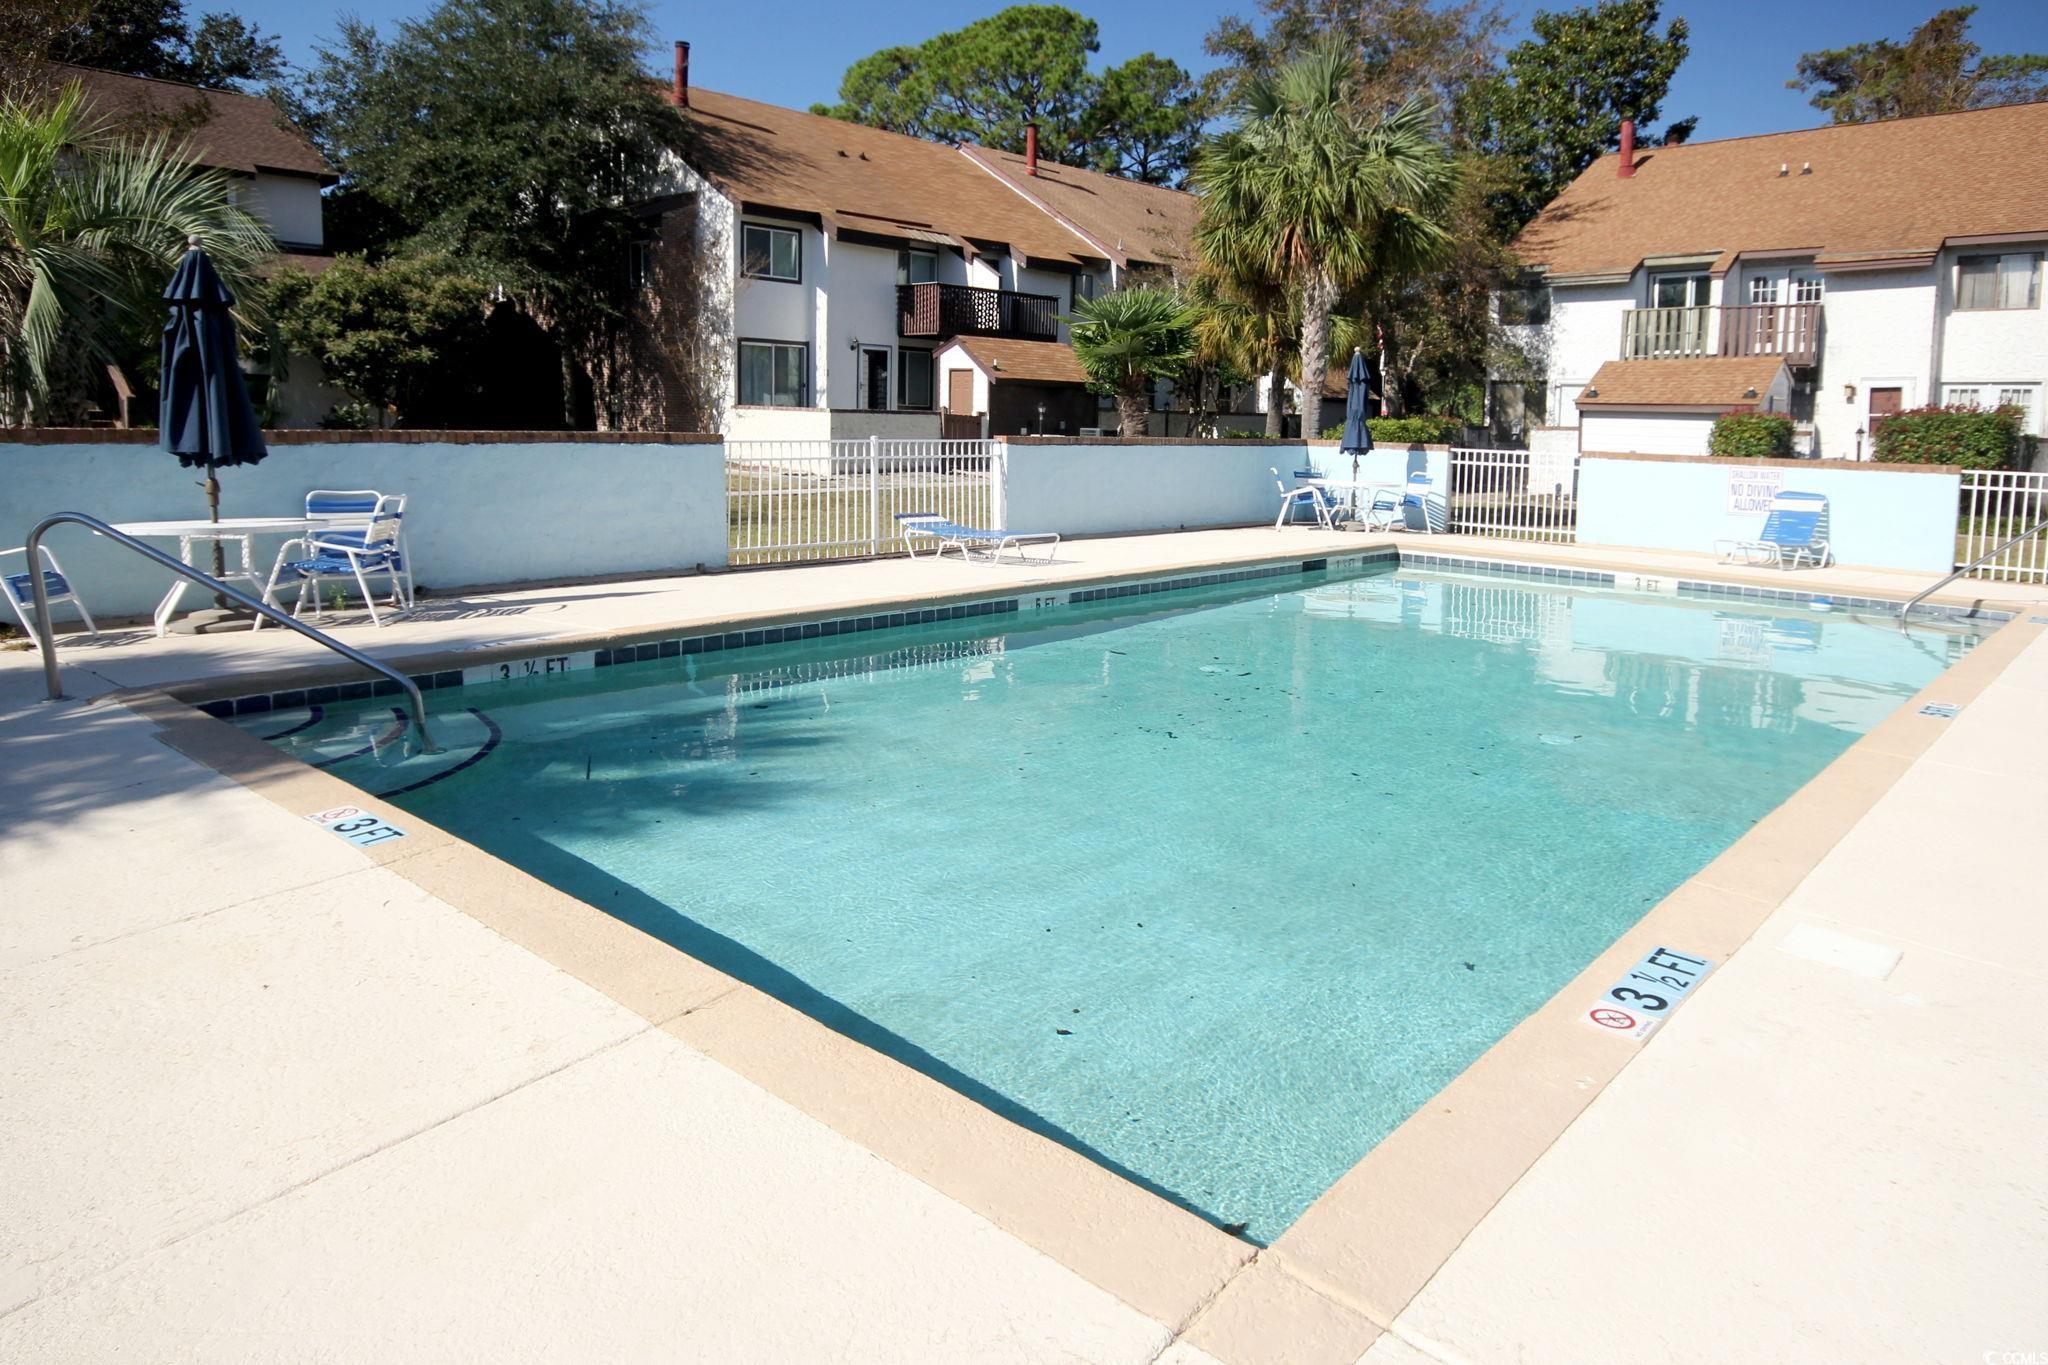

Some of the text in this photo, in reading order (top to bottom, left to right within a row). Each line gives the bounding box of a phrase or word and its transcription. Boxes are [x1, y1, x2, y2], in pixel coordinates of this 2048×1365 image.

[1731, 483, 1780, 498] NO DIVING
[1634, 576, 1661, 592] 3 FT
[500, 664, 510, 679] 3
[545, 657, 569, 674] FT
[333, 818, 379, 833] 3
[1611, 986, 1669, 1011] 3
[1647, 947, 1706, 977] FT
